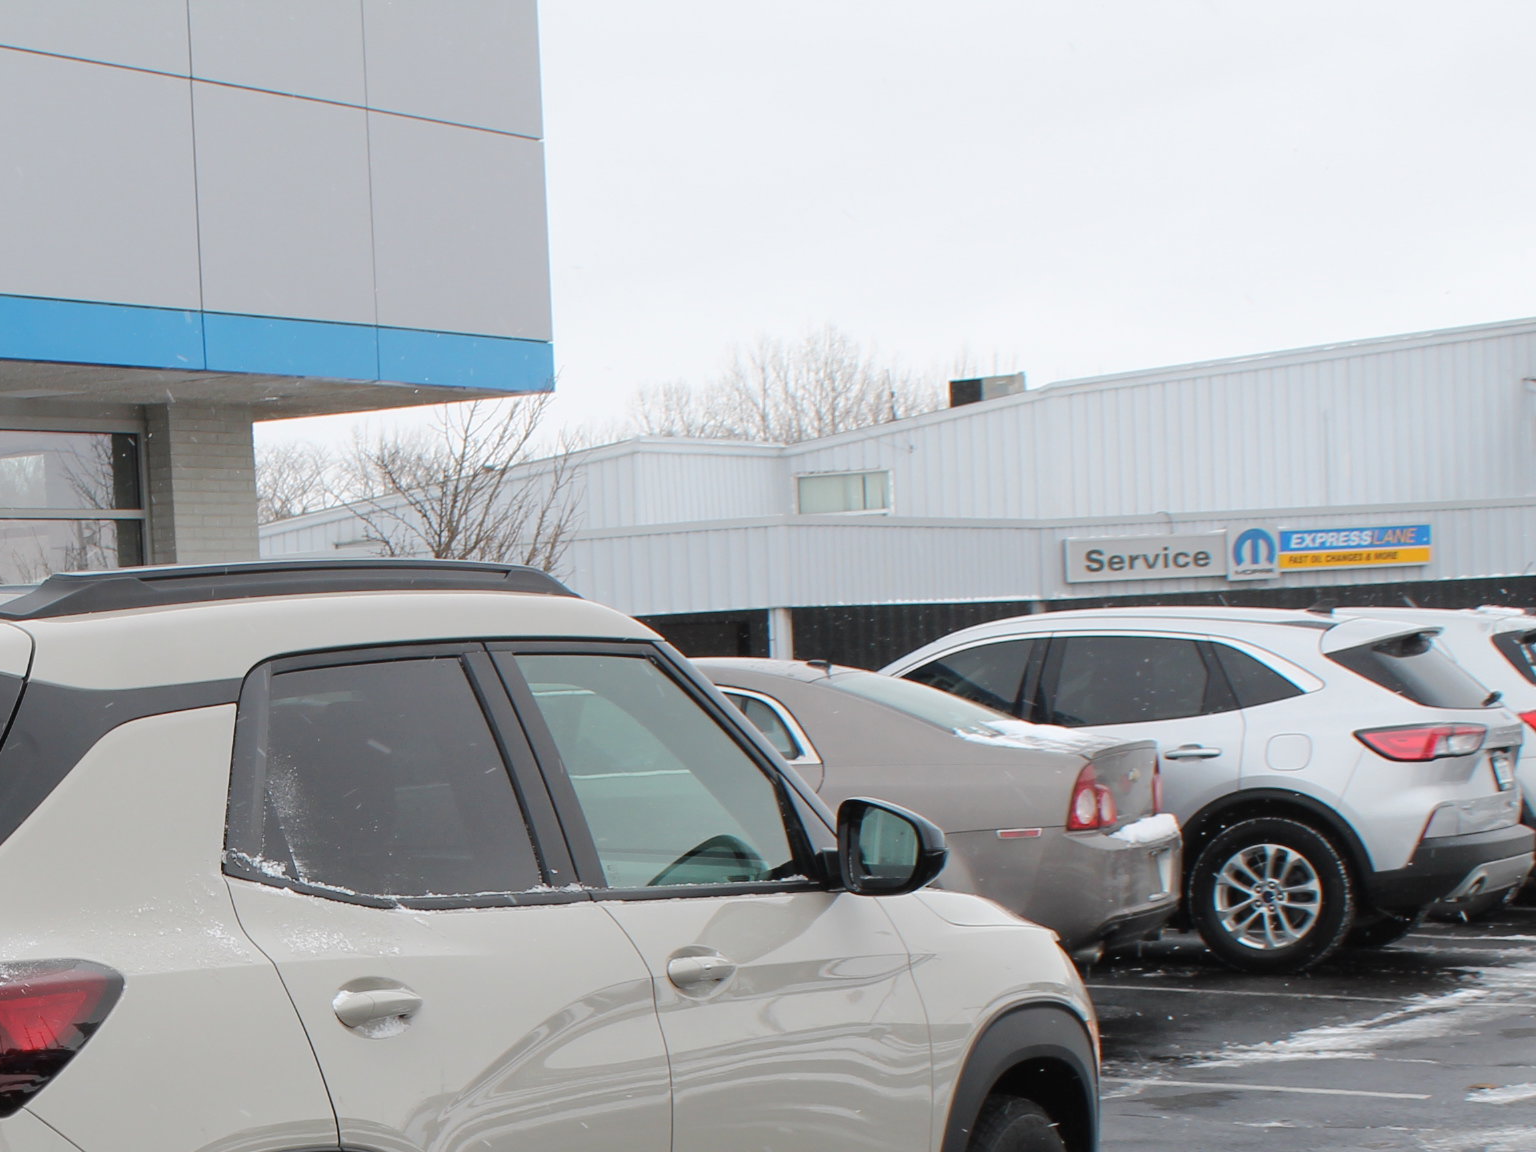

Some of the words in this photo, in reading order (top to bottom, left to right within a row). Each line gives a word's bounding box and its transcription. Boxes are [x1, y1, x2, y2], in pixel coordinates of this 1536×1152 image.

[1085, 546, 1212, 573] Service
[1325, 552, 1363, 563] CHANGES
[1374, 551, 1399, 560] MORE
